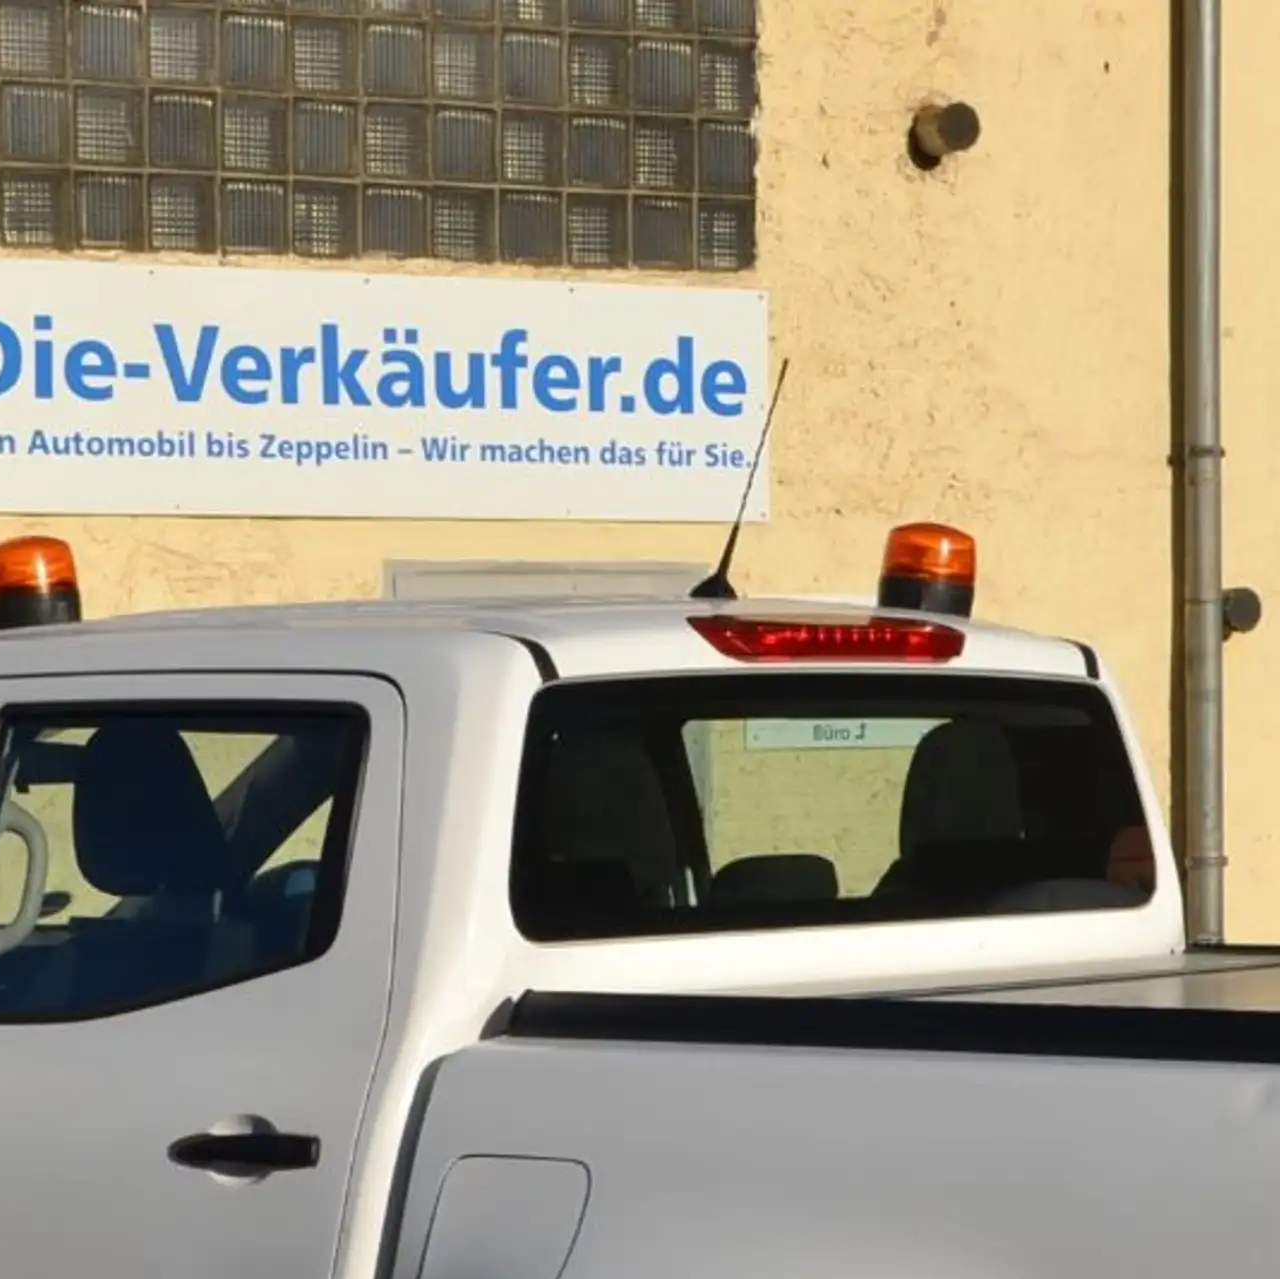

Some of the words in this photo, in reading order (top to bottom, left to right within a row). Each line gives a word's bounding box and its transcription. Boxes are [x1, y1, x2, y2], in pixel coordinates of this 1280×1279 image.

[27, 428, 196, 458] Automobil
[205, 431, 250, 458] bis
[258, 432, 389, 465] Zeppelin
[421, 436, 471, 462] Wir
[480, 438, 591, 464] machen
[599, 440, 647, 466] das
[655, 439, 697, 467] für
[705, 442, 753, 468] Sie.
[813, 723, 850, 741] Büro
